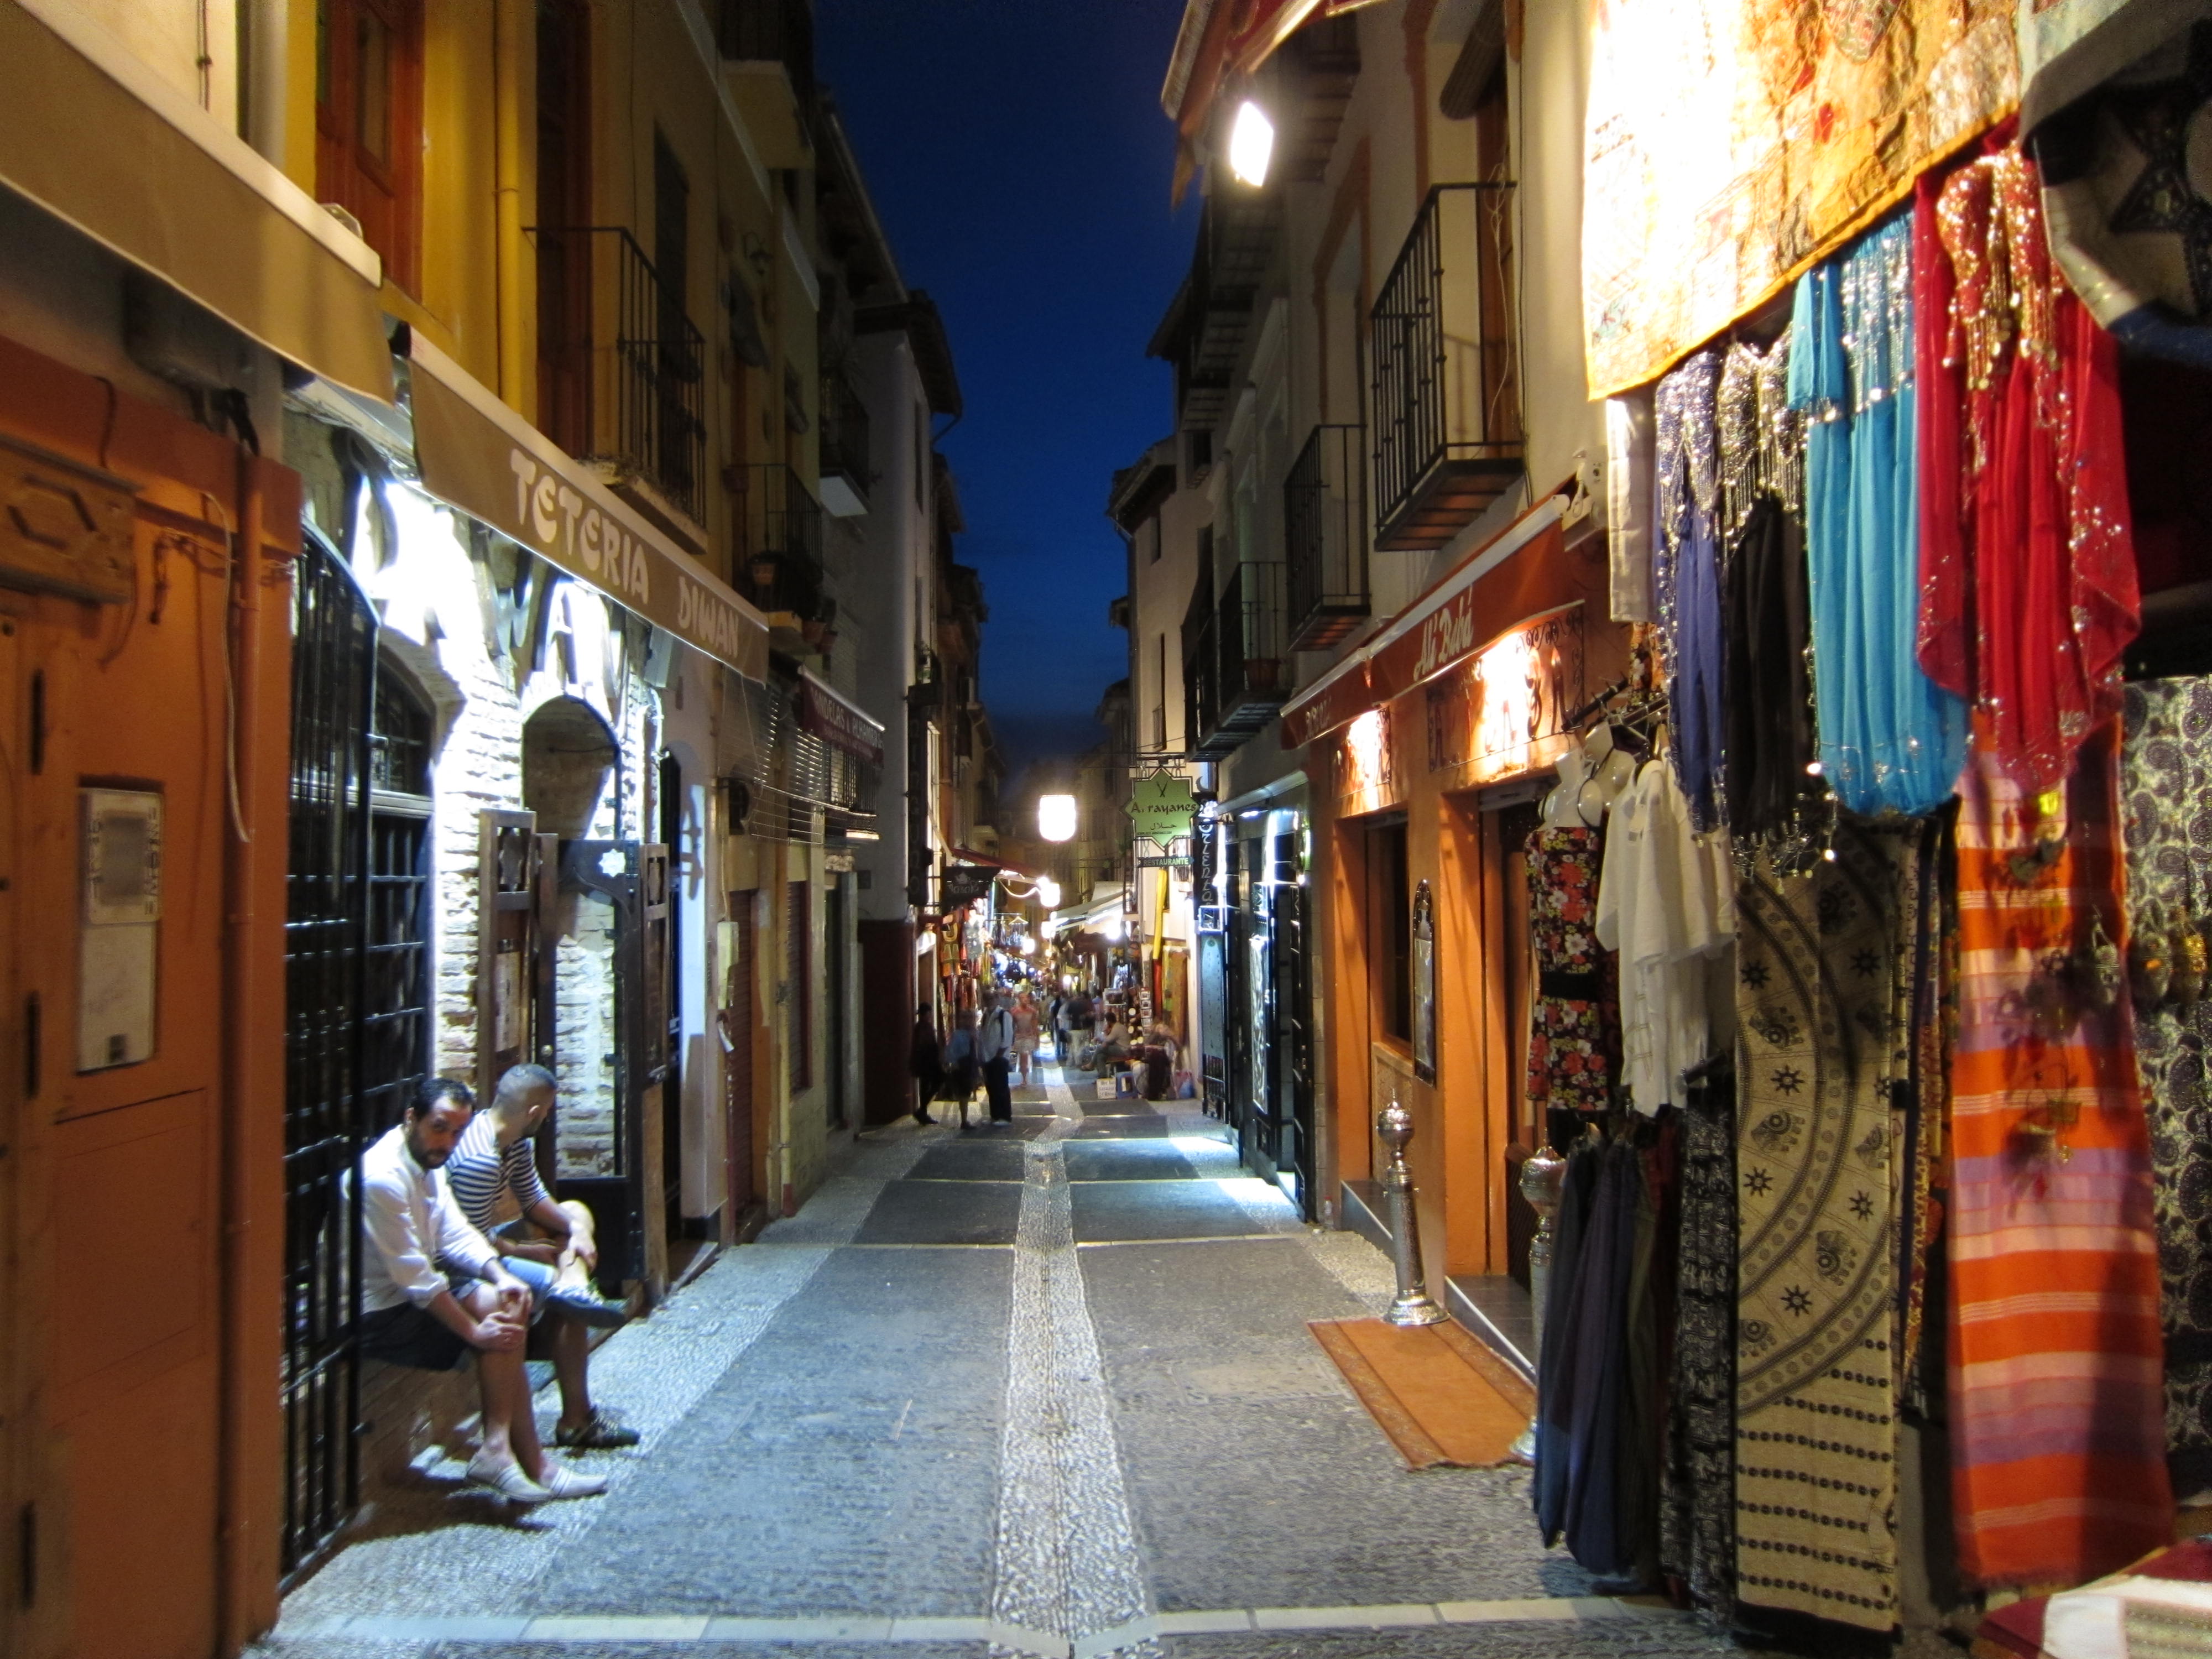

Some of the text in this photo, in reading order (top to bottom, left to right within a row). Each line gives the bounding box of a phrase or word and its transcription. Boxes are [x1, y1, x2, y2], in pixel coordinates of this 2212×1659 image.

[510, 448, 739, 659] TETERIA DIWAN
[1413, 584, 1474, 681] Ali Babá
[1144, 858, 1188, 867] RESTAURANTE
